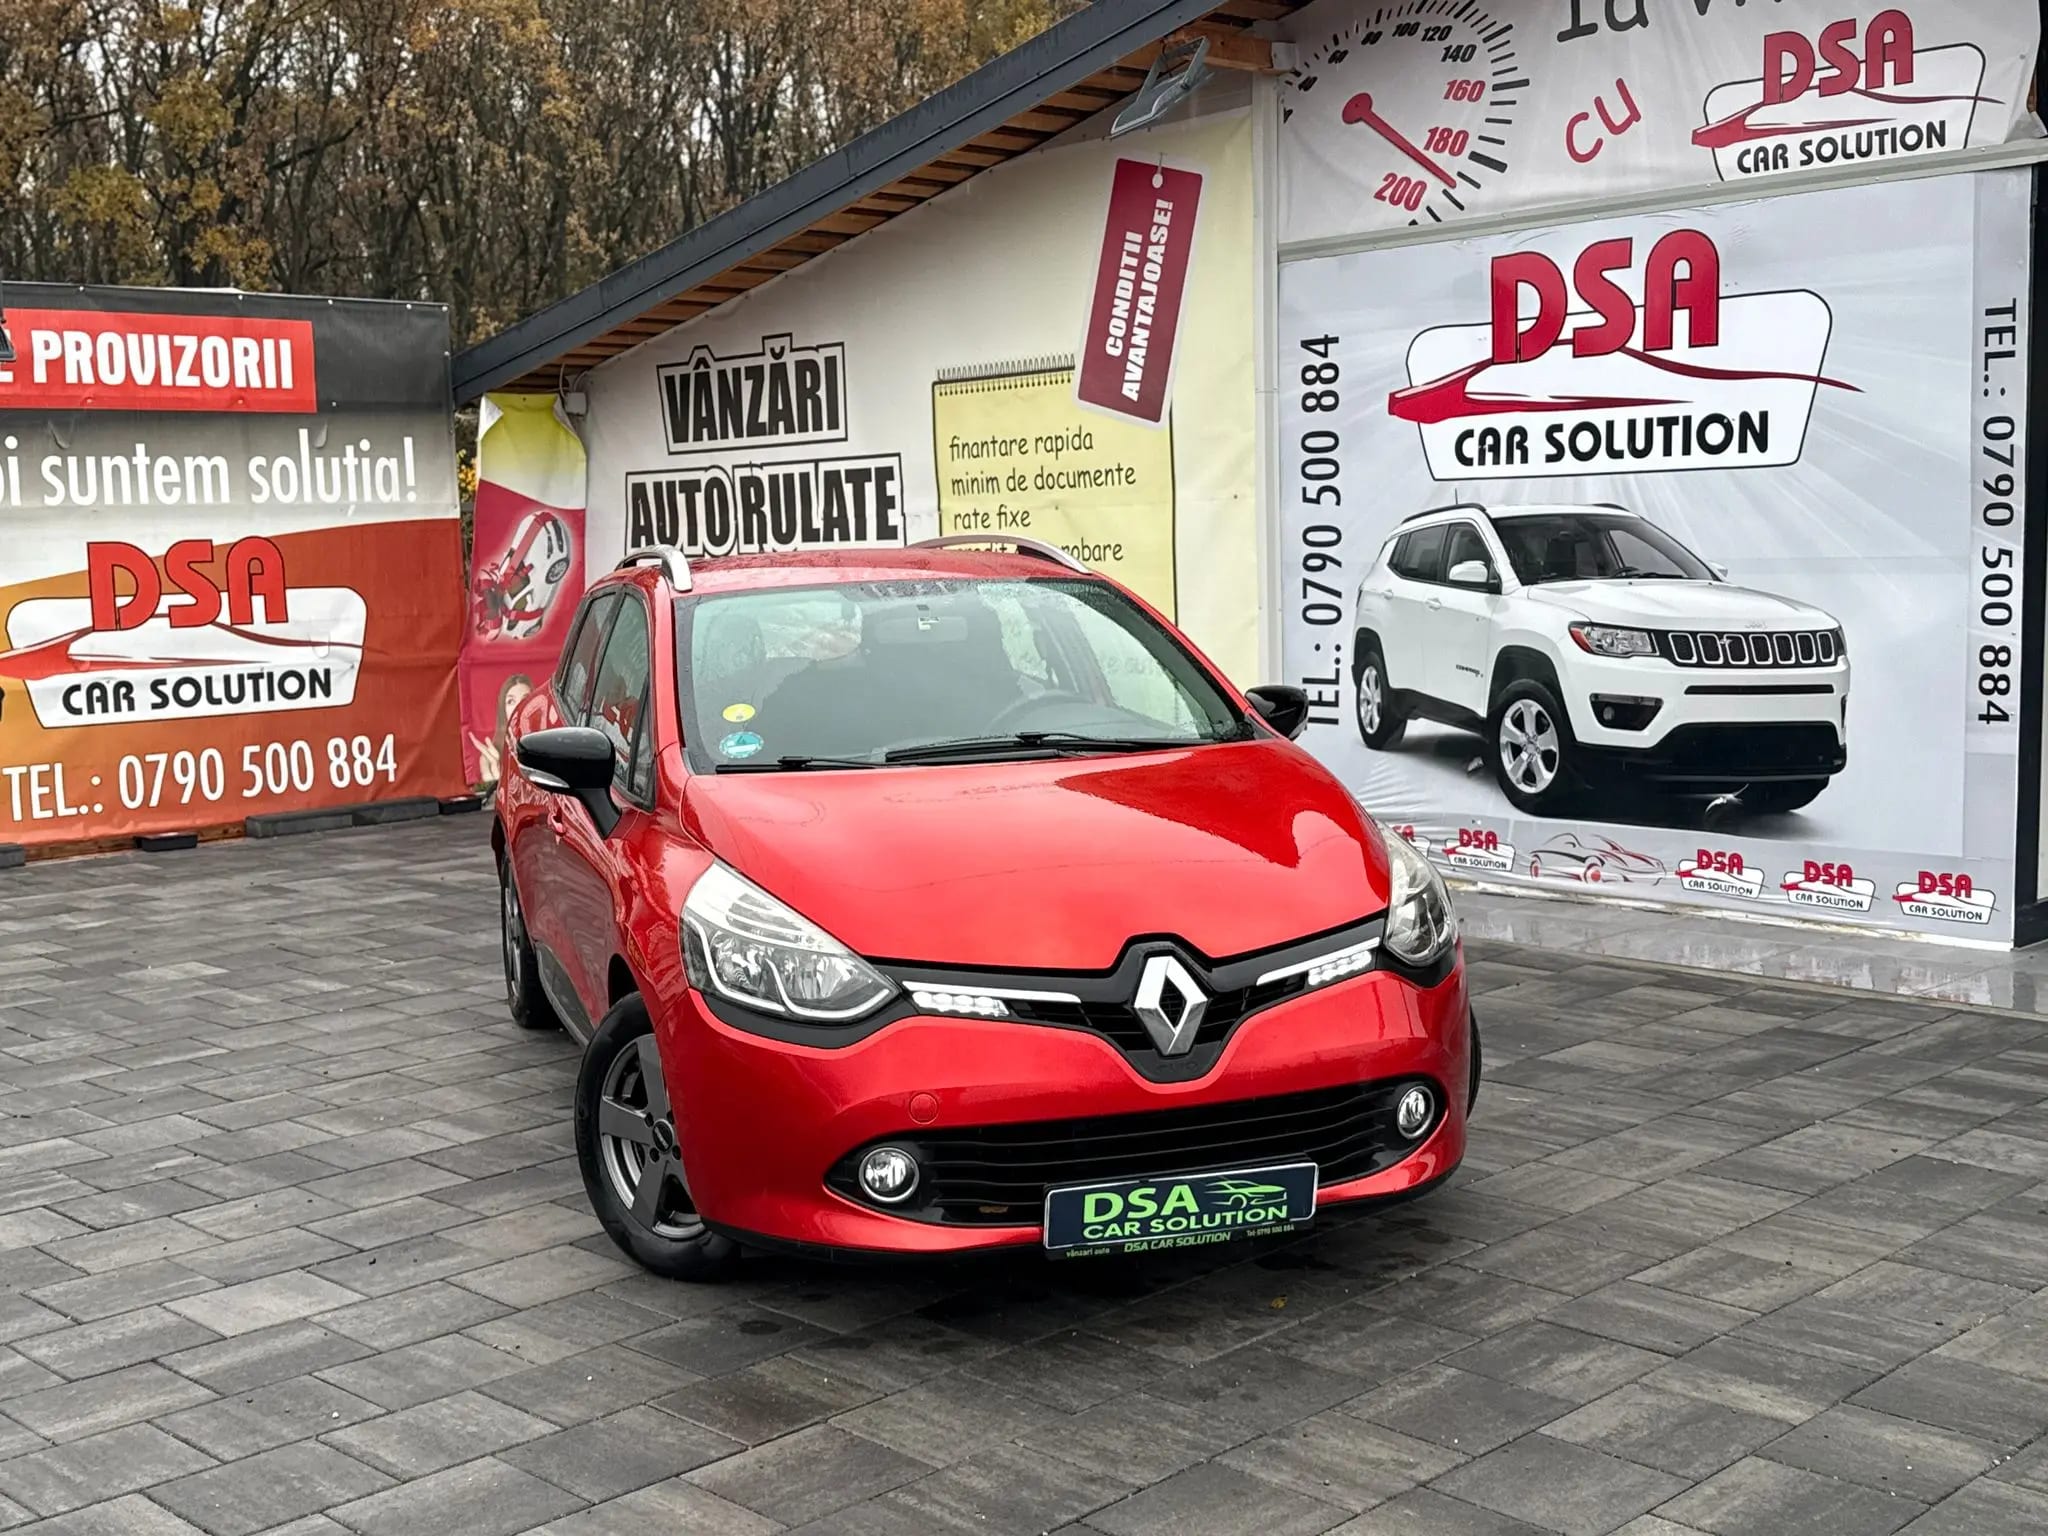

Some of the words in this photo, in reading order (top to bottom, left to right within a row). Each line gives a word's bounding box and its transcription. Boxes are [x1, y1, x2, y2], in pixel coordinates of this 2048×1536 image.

[1392, 22, 1421, 37] 100
[1421, 25, 1452, 42] 120
[1440, 44, 1477, 62] 140
[1763, 9, 1914, 104] DSA
[1443, 80, 1485, 102] 160
[1565, 77, 1642, 164] cu
[1424, 126, 1469, 156] 180
[1737, 143, 1789, 174] CAR
[1800, 120, 1946, 167] SOLUTION
[1373, 172, 1427, 211] 200
[1105, 231, 1143, 358] CONDITII
[1121, 199, 1174, 402] AVANTAJOASE!
[1491, 229, 1720, 364] DSA
[31, 330, 294, 389] PROVIZORII
[1300, 334, 1340, 413] 884
[664, 345, 840, 444] VÂNZĂRI
[949, 435, 1029, 461] finantare
[1035, 425, 1094, 461] rapida
[1454, 425, 1529, 467] CAR
[1545, 410, 1768, 463] SOLUTION
[41, 443, 230, 506] suntem
[952, 471, 1000, 496] minim
[1006, 467, 1028, 492] de
[1034, 463, 1136, 491] documente
[1301, 430, 1341, 506] 500
[1982, 415, 2015, 527] 0790
[631, 476, 730, 549] AUTO
[739, 466, 898, 545] RULATE
[954, 508, 991, 531] rate
[997, 504, 1031, 531] fixe
[1060, 537, 1124, 562] robare
[87, 536, 289, 631] DSA
[1302, 524, 1342, 625] 0790
[1980, 546, 2013, 626] 500
[62, 679, 134, 716] CAR
[151, 668, 332, 709] SOLUTION
[1977, 644, 2012, 725] 884
[118, 748, 225, 810] 0790
[242, 740, 314, 798] 500
[328, 734, 398, 788] 884
[1458, 828, 1498, 851] DSA
[1454, 856, 1467, 865] CAR
[1469, 858, 1507, 869] SOLUTION
[1697, 849, 1743, 876] DSA
[1804, 860, 1853, 888] DSA
[1688, 879, 1705, 889] CAR
[1708, 881, 1753, 896] SOLUTION
[1795, 893, 1813, 901] CAR
[1815, 895, 1863, 909] SOLUTION
[1918, 871, 1972, 899] DSA
[1909, 904, 1928, 914] CAR
[1931, 907, 1983, 921] SOLUTION
[1082, 1221, 1141, 1240] CAR
[1150, 1205, 1288, 1233] SOLUTION
[1083, 1184, 1200, 1224] DSA
[1124, 1242, 1148, 1252] DSA
[1151, 1238, 1174, 1250] CAR
[1176, 1232, 1231, 1247] SOLUTION
